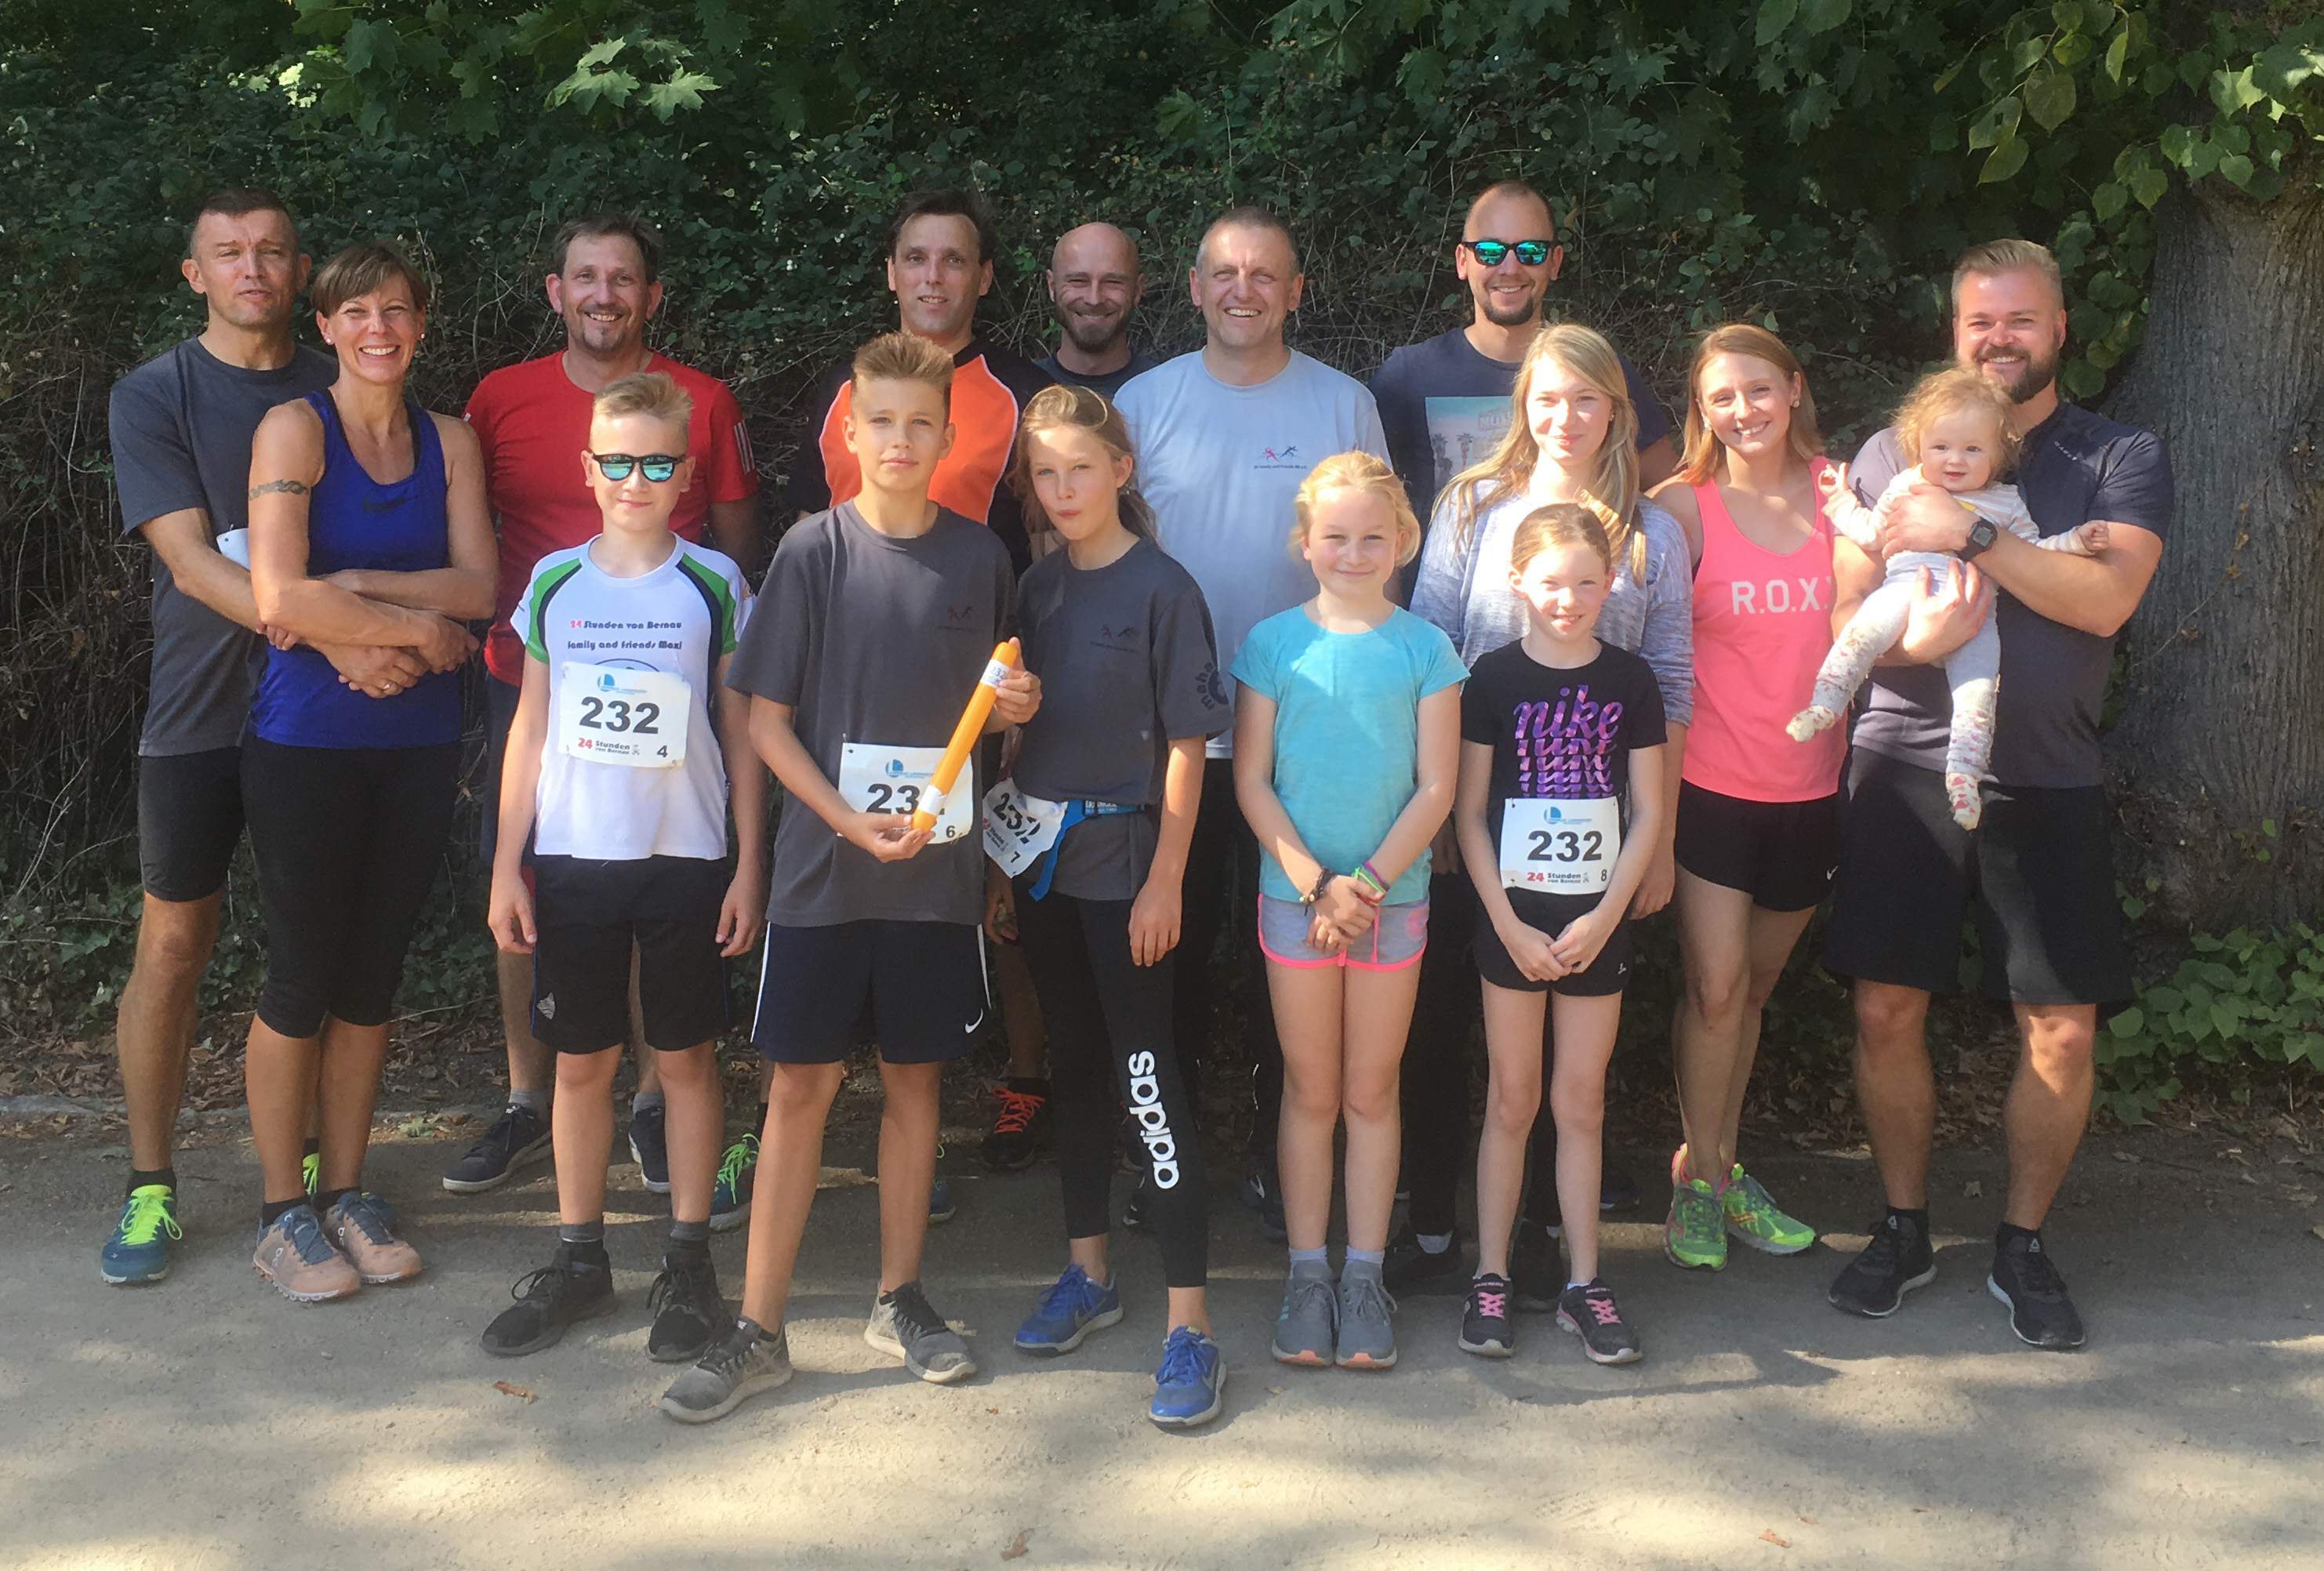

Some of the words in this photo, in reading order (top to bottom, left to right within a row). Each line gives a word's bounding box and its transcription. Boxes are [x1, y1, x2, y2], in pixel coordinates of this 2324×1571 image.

[584, 620, 624, 629] Stunden
[647, 621, 682, 629] Bernau
[568, 640, 596, 651] family
[598, 640, 619, 649] and
[621, 640, 656, 649] friends
[658, 640, 682, 650] Maxi
[579, 696, 660, 735] 232
[1513, 684, 1623, 739] nike
[578, 737, 594, 749] 24
[595, 740, 630, 750] Stunden
[656, 745, 668, 758] 4
[946, 825, 956, 838] 6
[1527, 829, 1603, 862] 232
[1527, 871, 1545, 882] 24
[1600, 869, 1607, 882] 8
[1128, 1050, 1180, 1189] adidas
